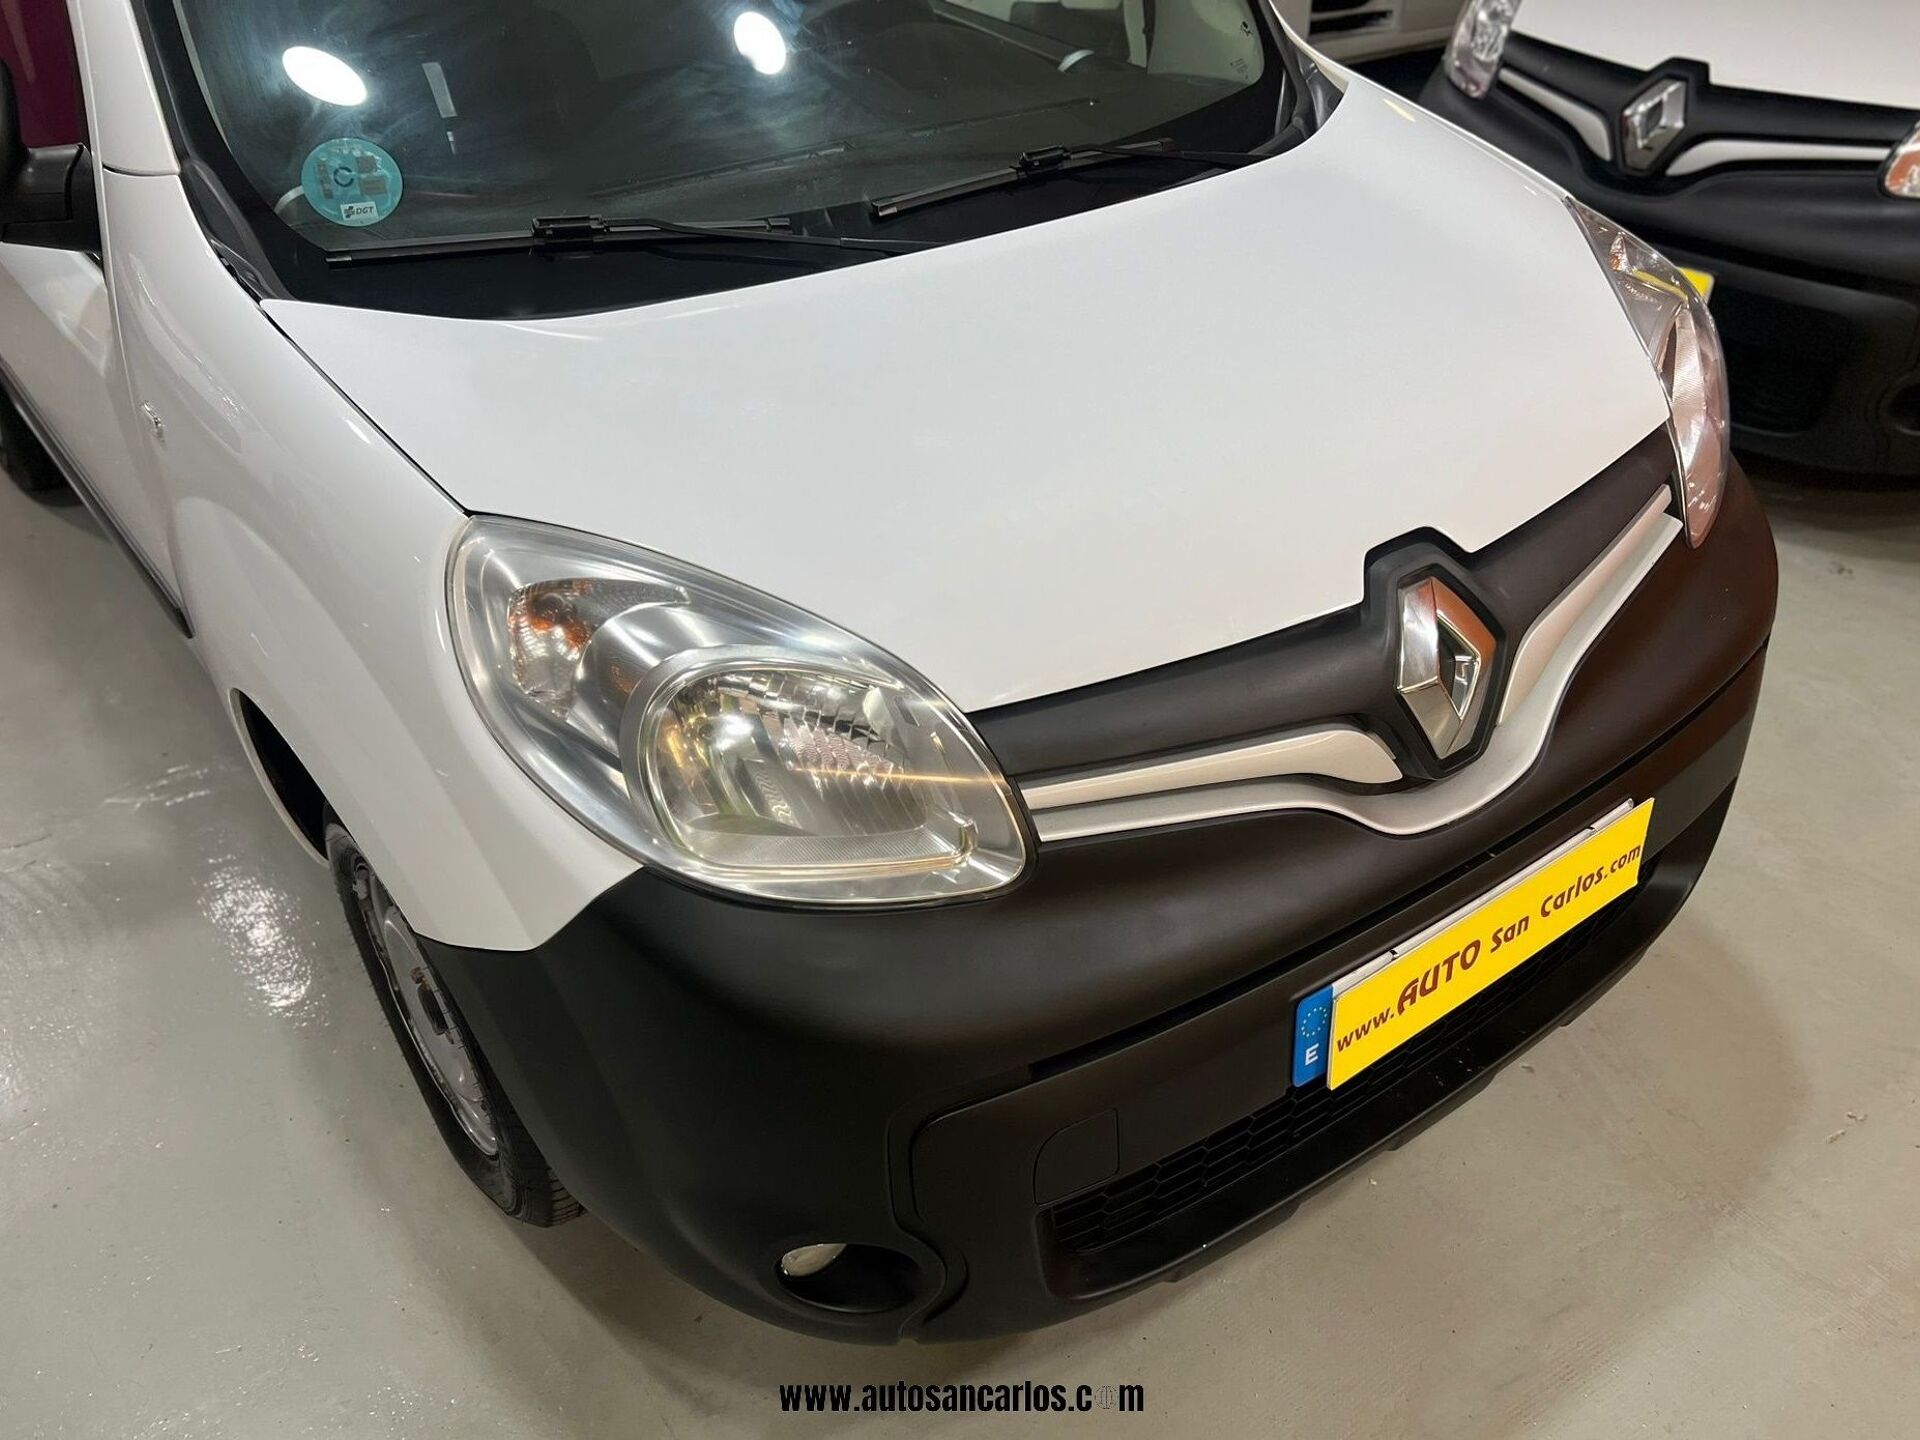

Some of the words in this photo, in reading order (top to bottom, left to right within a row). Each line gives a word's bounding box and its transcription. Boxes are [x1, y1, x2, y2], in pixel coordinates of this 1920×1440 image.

[356, 206, 374, 215] DGT
[1490, 915, 1529, 953] San
[1540, 844, 1641, 918] Carlos.com
[1305, 1043, 1319, 1066] E
